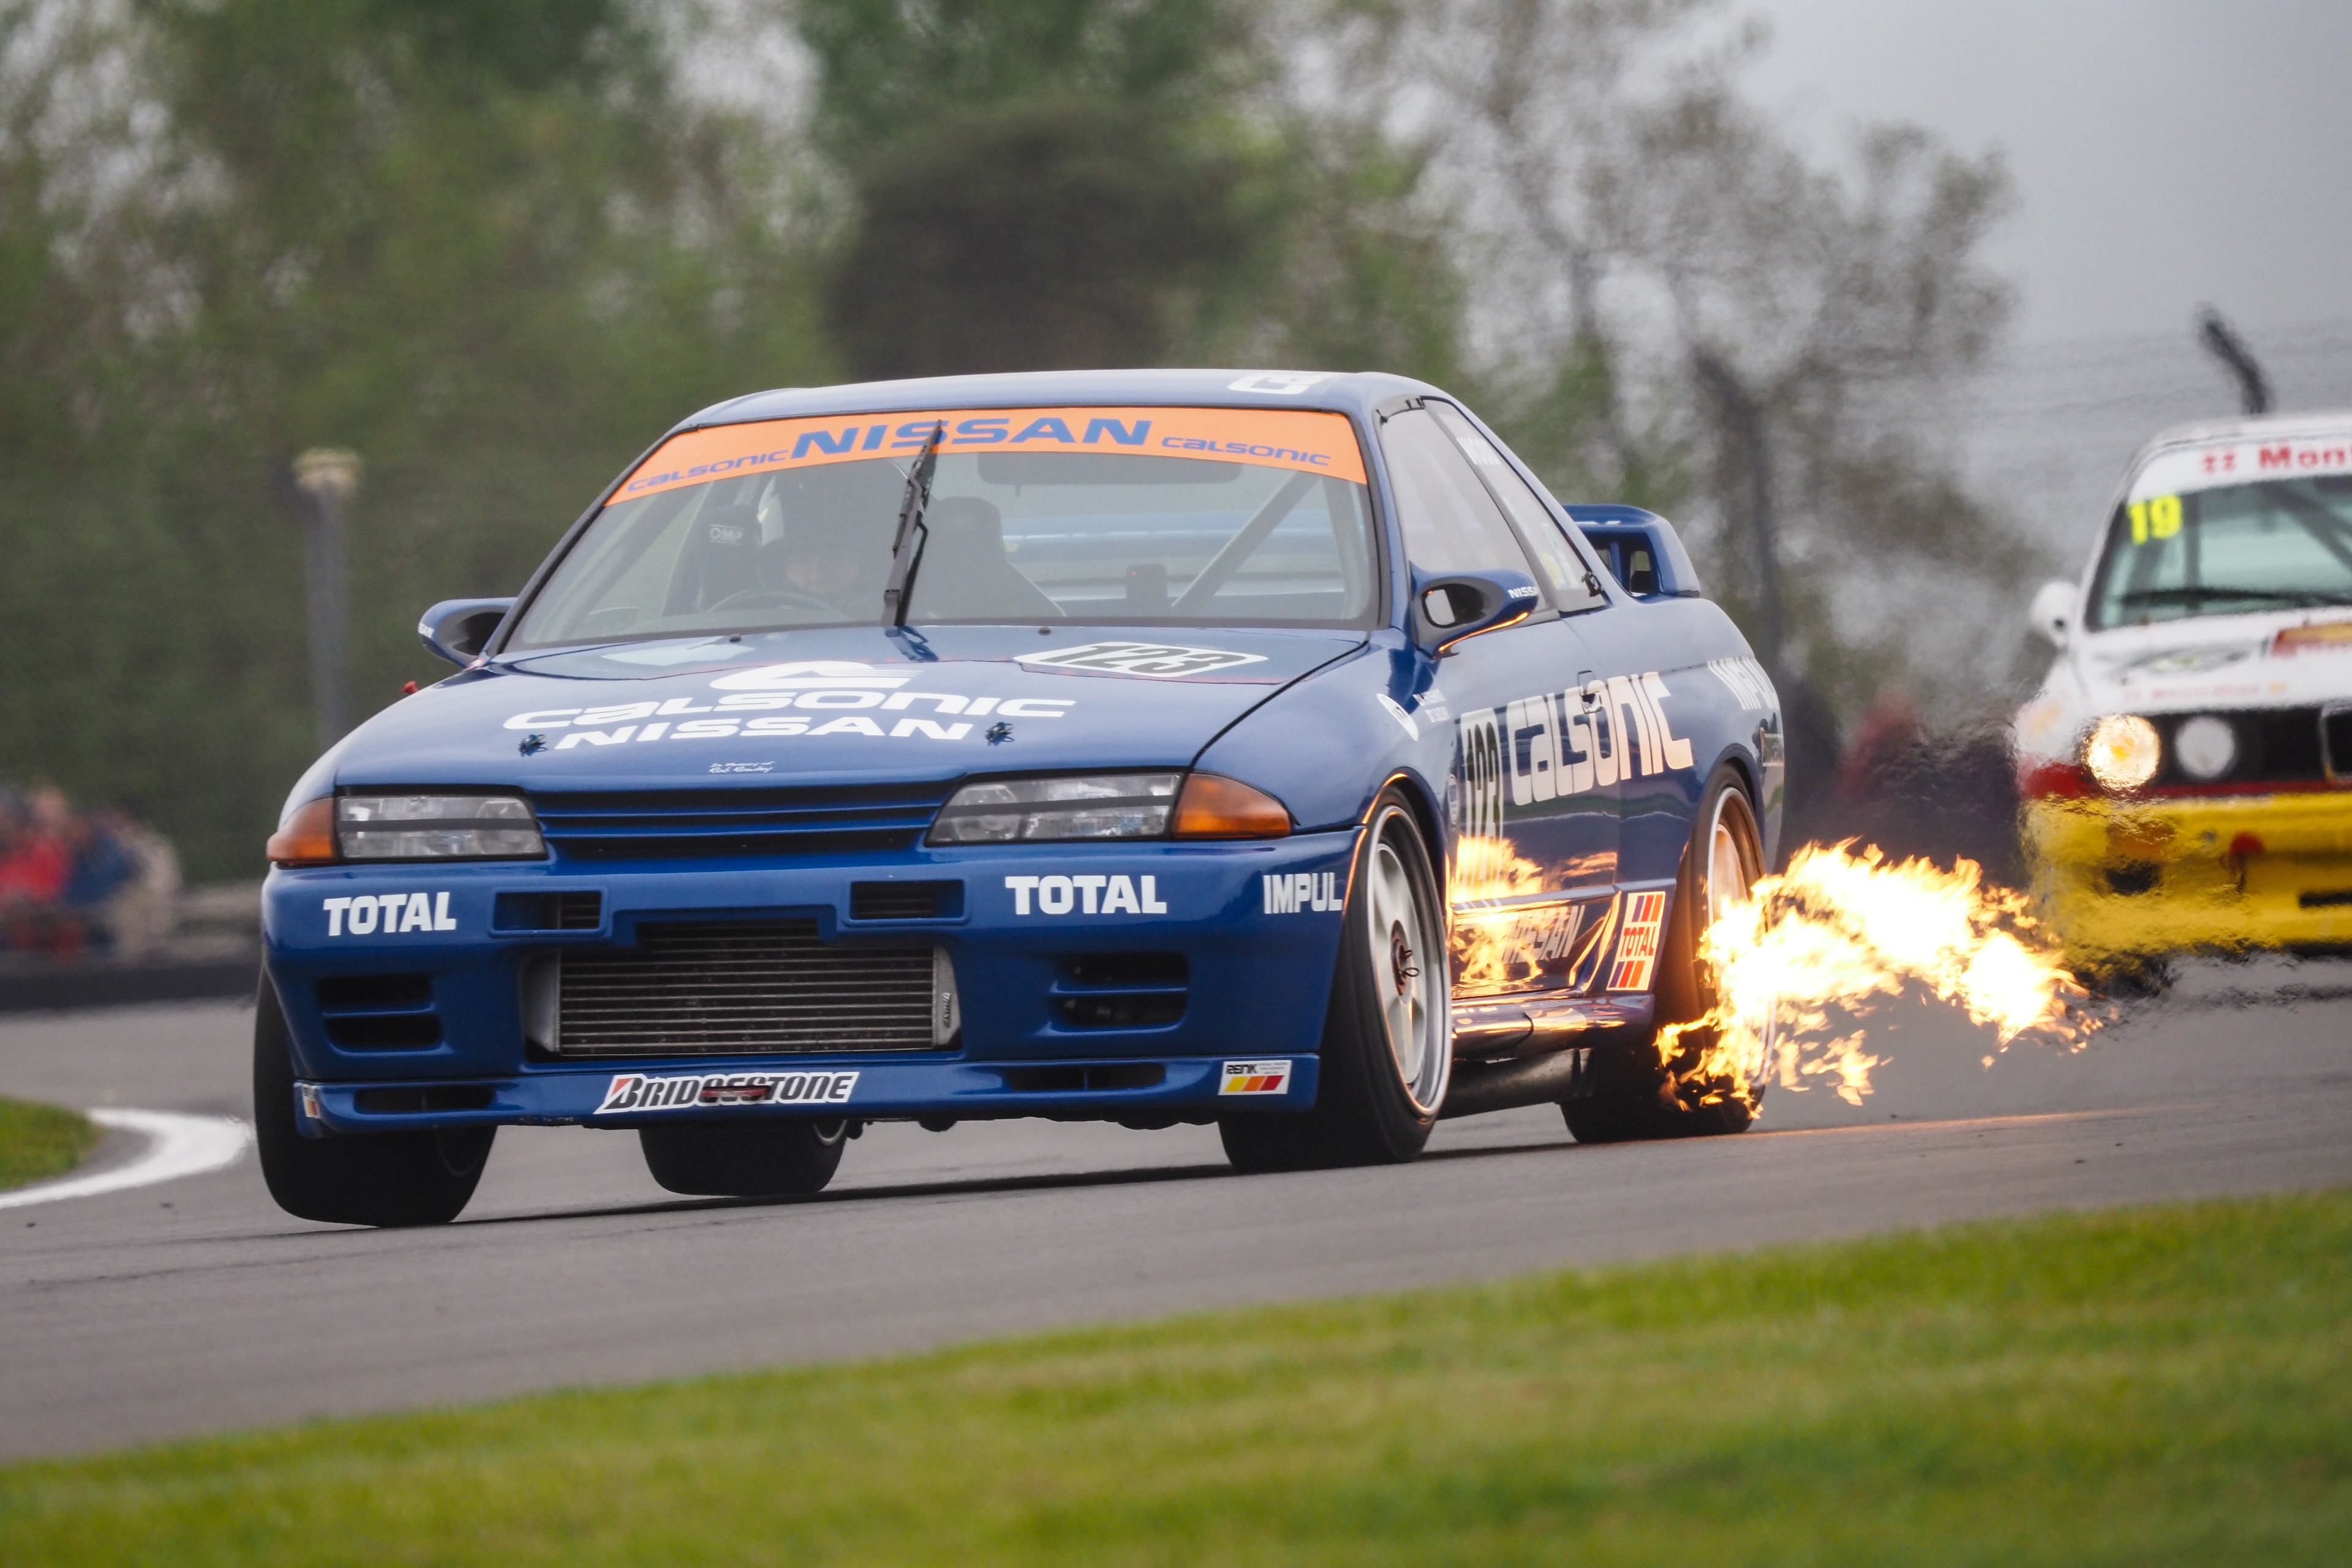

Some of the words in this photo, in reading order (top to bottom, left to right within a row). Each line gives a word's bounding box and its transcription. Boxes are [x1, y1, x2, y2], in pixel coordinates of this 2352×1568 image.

[791, 417, 1152, 459] NISSAN
[2258, 445, 2352, 470] Mon
[2129, 494, 2182, 544] 19
[1507, 586, 1536, 598] NISS
[1037, 645, 1248, 674] 123
[554, 716, 974, 750] NISSAN
[1005, 875, 1167, 914] TOTAL
[1263, 872, 1343, 914] IMPUL
[323, 892, 457, 937] TOTAL
[1620, 925, 1656, 958] TOTAL
